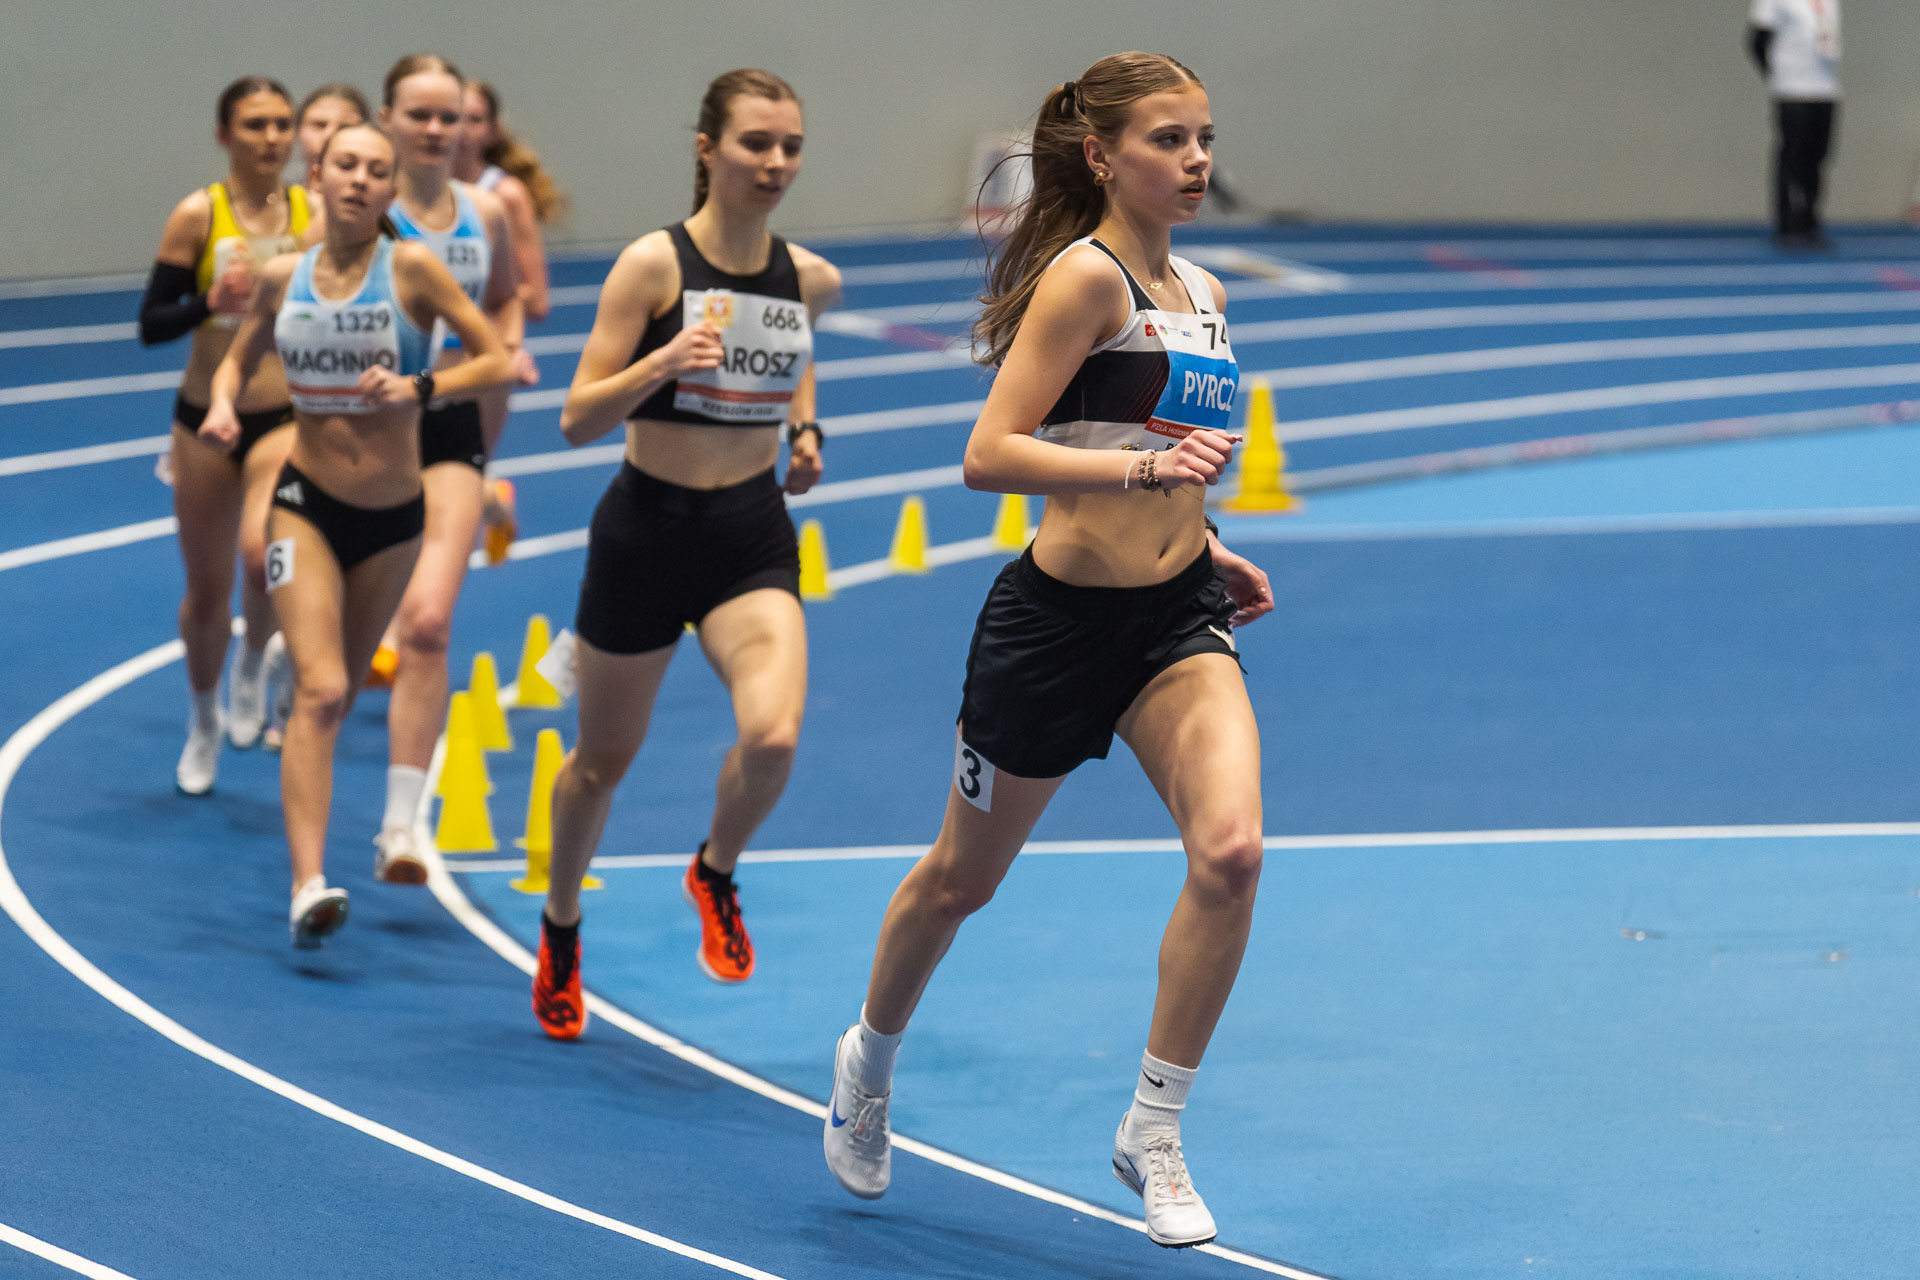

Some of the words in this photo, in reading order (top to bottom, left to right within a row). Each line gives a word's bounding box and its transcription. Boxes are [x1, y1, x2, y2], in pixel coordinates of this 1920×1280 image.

[333, 310, 390, 333] 1329
[762, 306, 800, 331] 668
[1181, 370, 1236, 412] PYRCZ
[1151, 422, 1168, 432] PZLA
[268, 546, 284, 582] 6
[959, 747, 982, 799] 3
